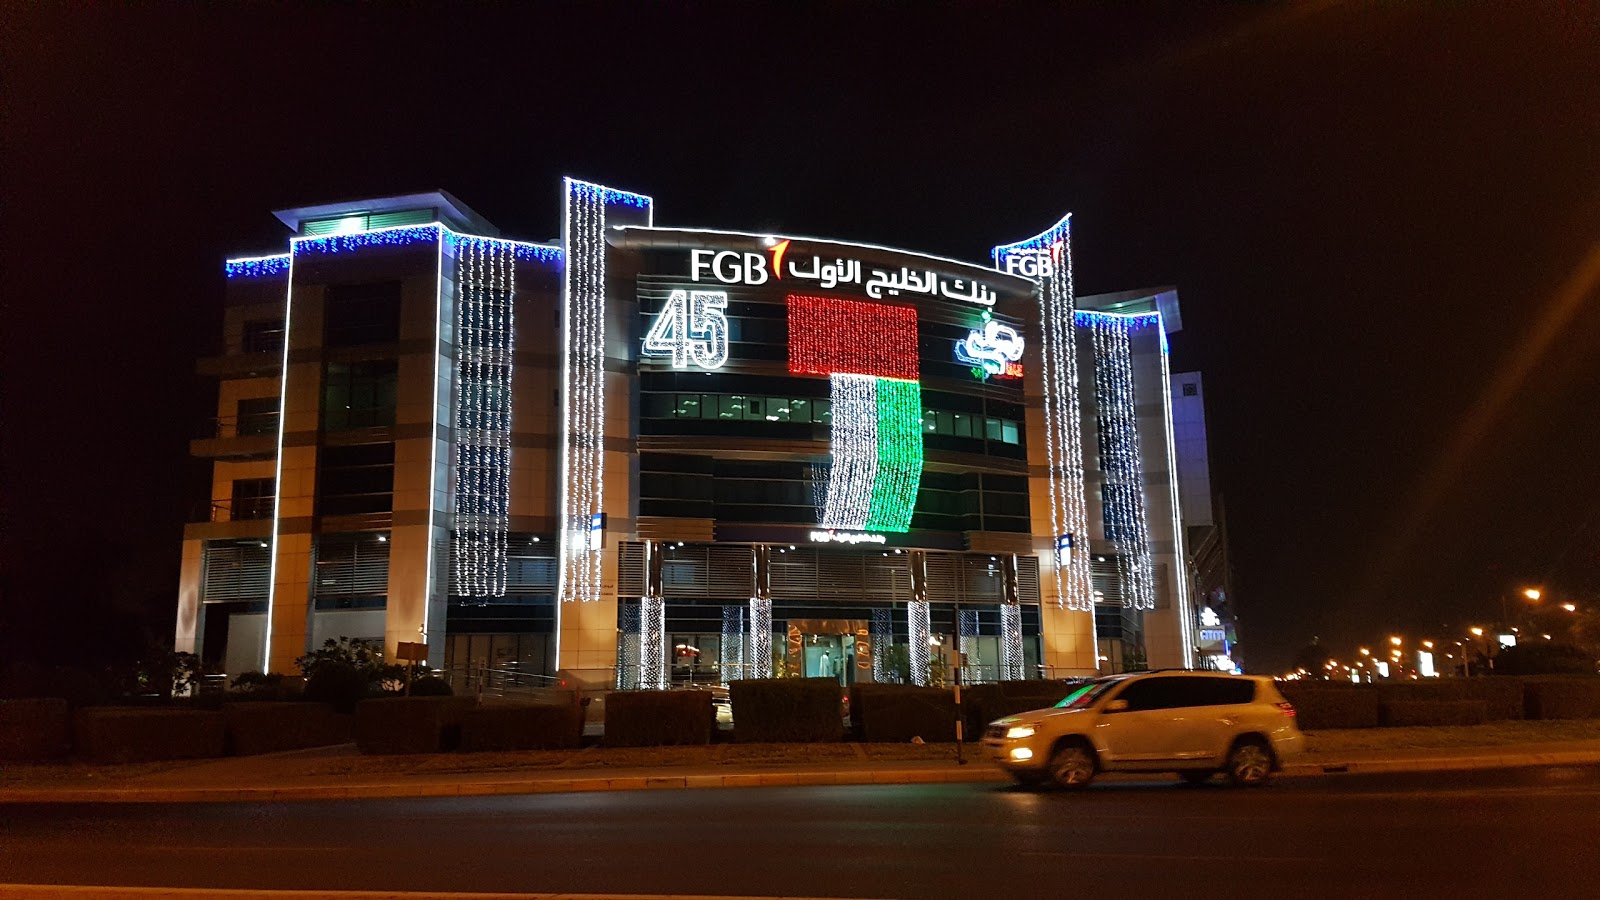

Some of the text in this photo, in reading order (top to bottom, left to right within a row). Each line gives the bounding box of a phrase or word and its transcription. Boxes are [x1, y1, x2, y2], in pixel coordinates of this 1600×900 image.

[691, 249, 769, 285] FGB
[788, 256, 997, 312] بنك الخليج الأول
[1006, 254, 1053, 277] FGB
[645, 290, 728, 370] 45
